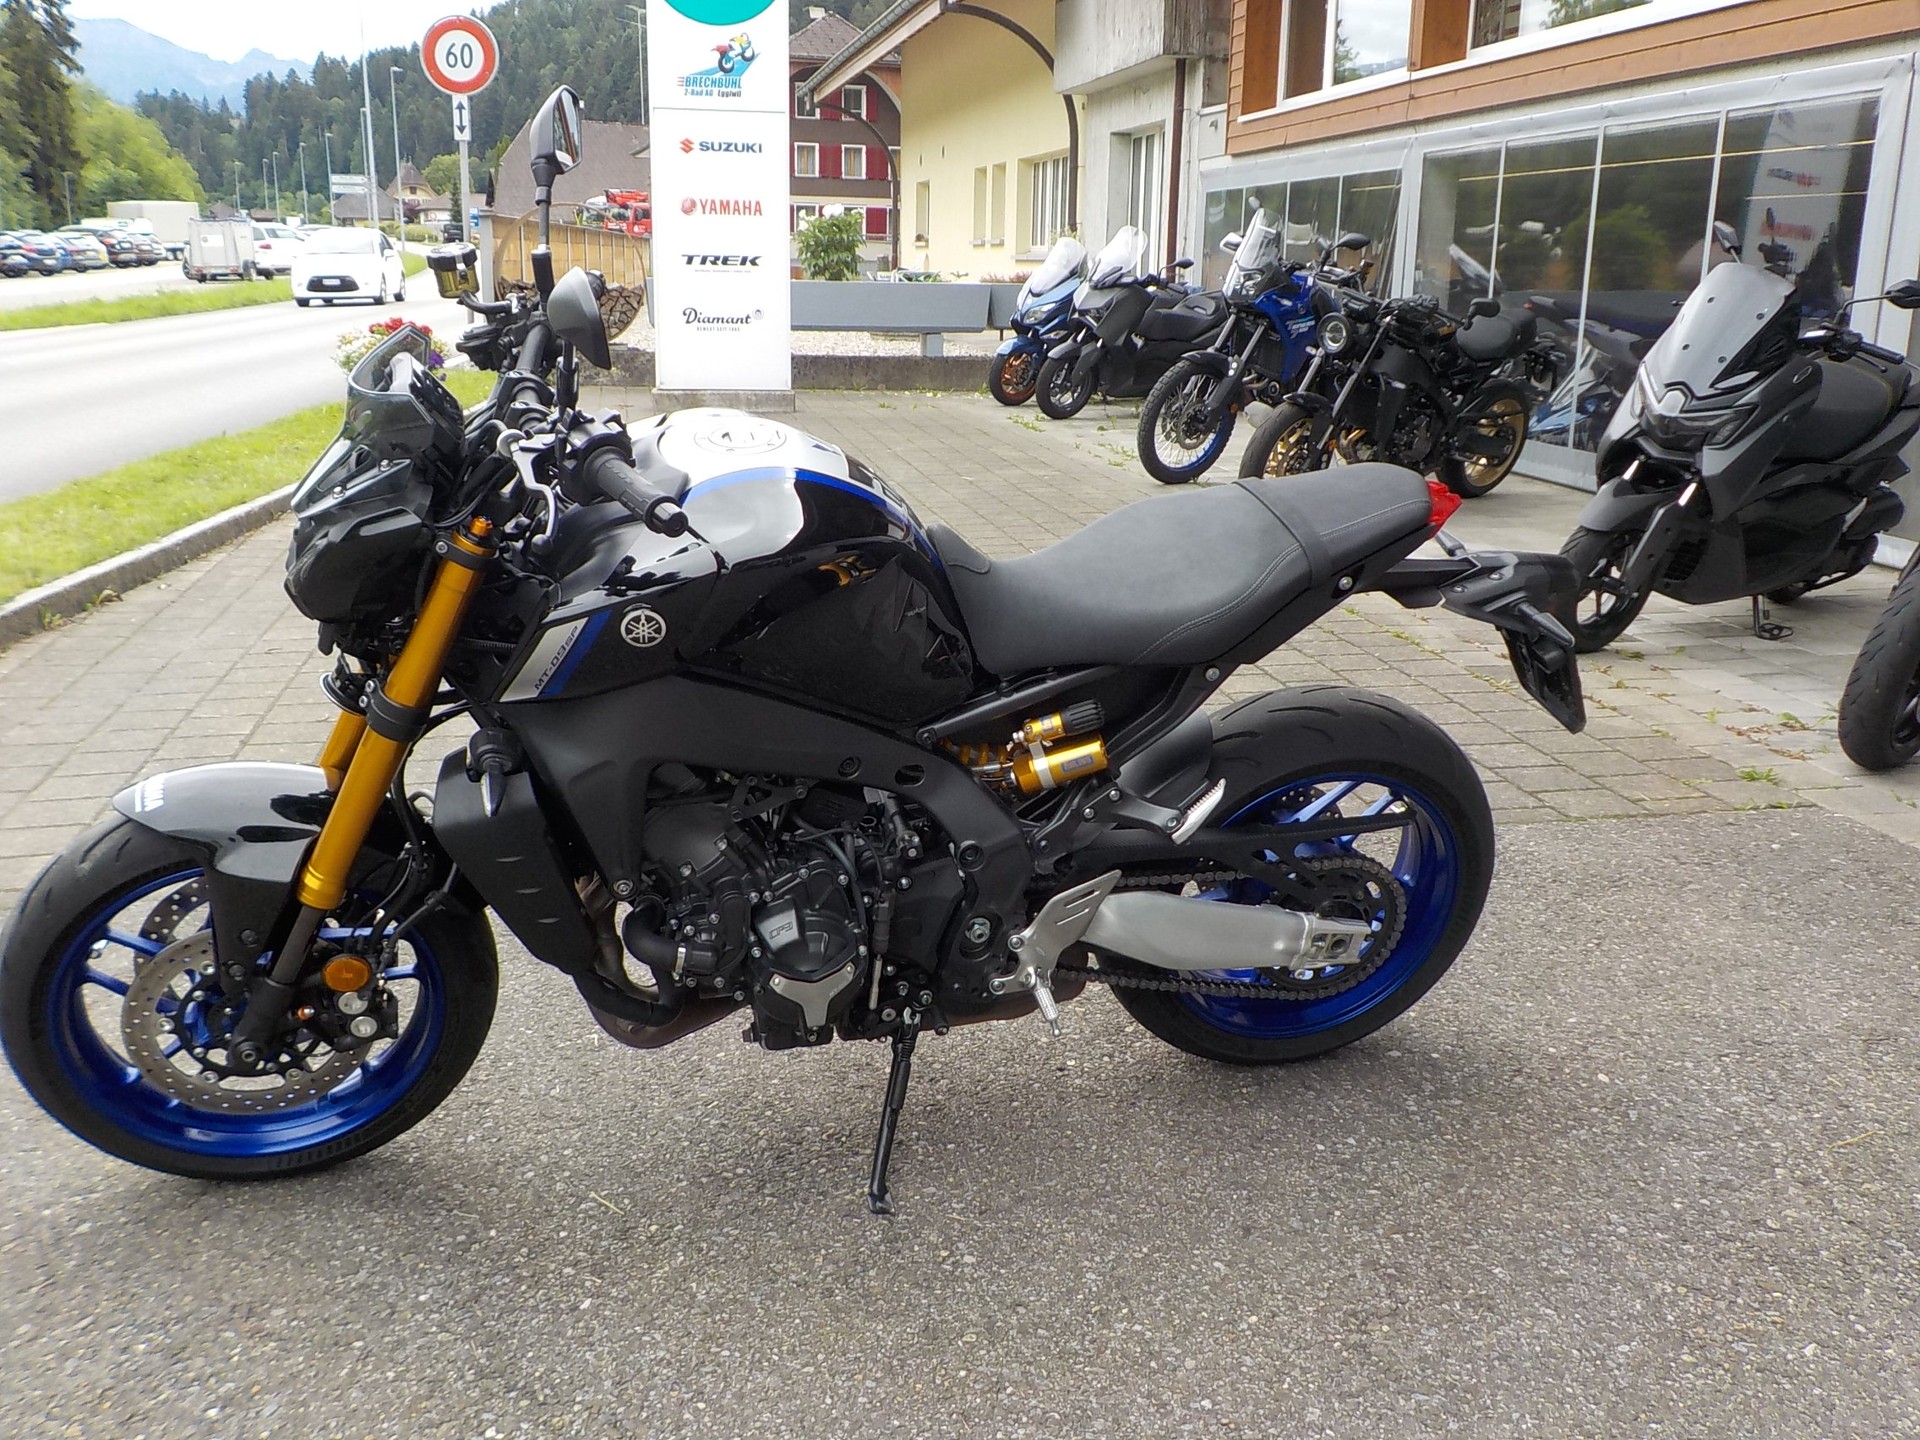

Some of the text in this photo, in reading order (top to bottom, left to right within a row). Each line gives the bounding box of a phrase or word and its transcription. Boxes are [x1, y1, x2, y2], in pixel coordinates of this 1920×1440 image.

[446, 43, 473, 69] 60
[698, 141, 762, 153] SUZUKI
[699, 198, 763, 216] YAMAHA
[681, 254, 763, 267] TREK
[682, 307, 752, 325] Diamant
